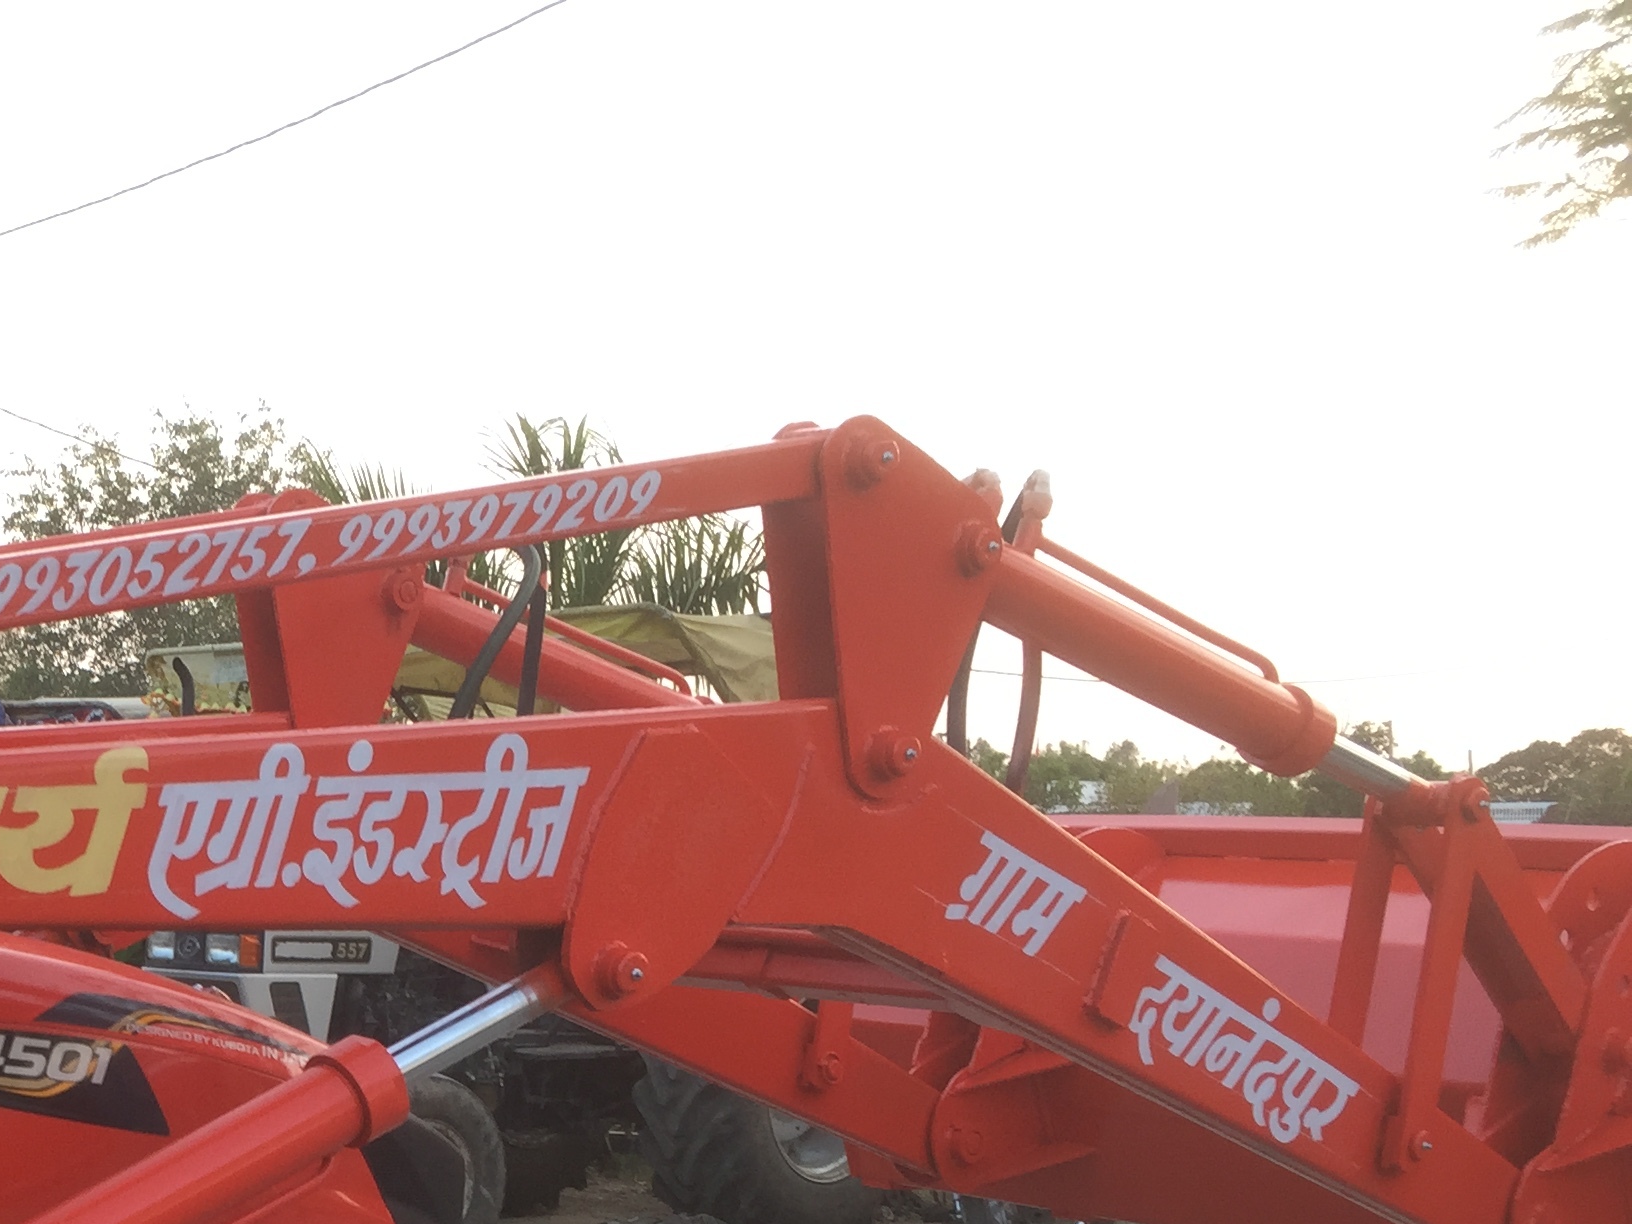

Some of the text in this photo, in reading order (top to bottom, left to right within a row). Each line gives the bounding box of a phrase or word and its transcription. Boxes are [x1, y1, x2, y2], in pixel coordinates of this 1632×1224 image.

[331, 469, 662, 567] 9993979209
[943, 829, 1089, 957] ग्राम
[335, 941, 369, 961] 557
[261, 1045, 279, 1061] IN
